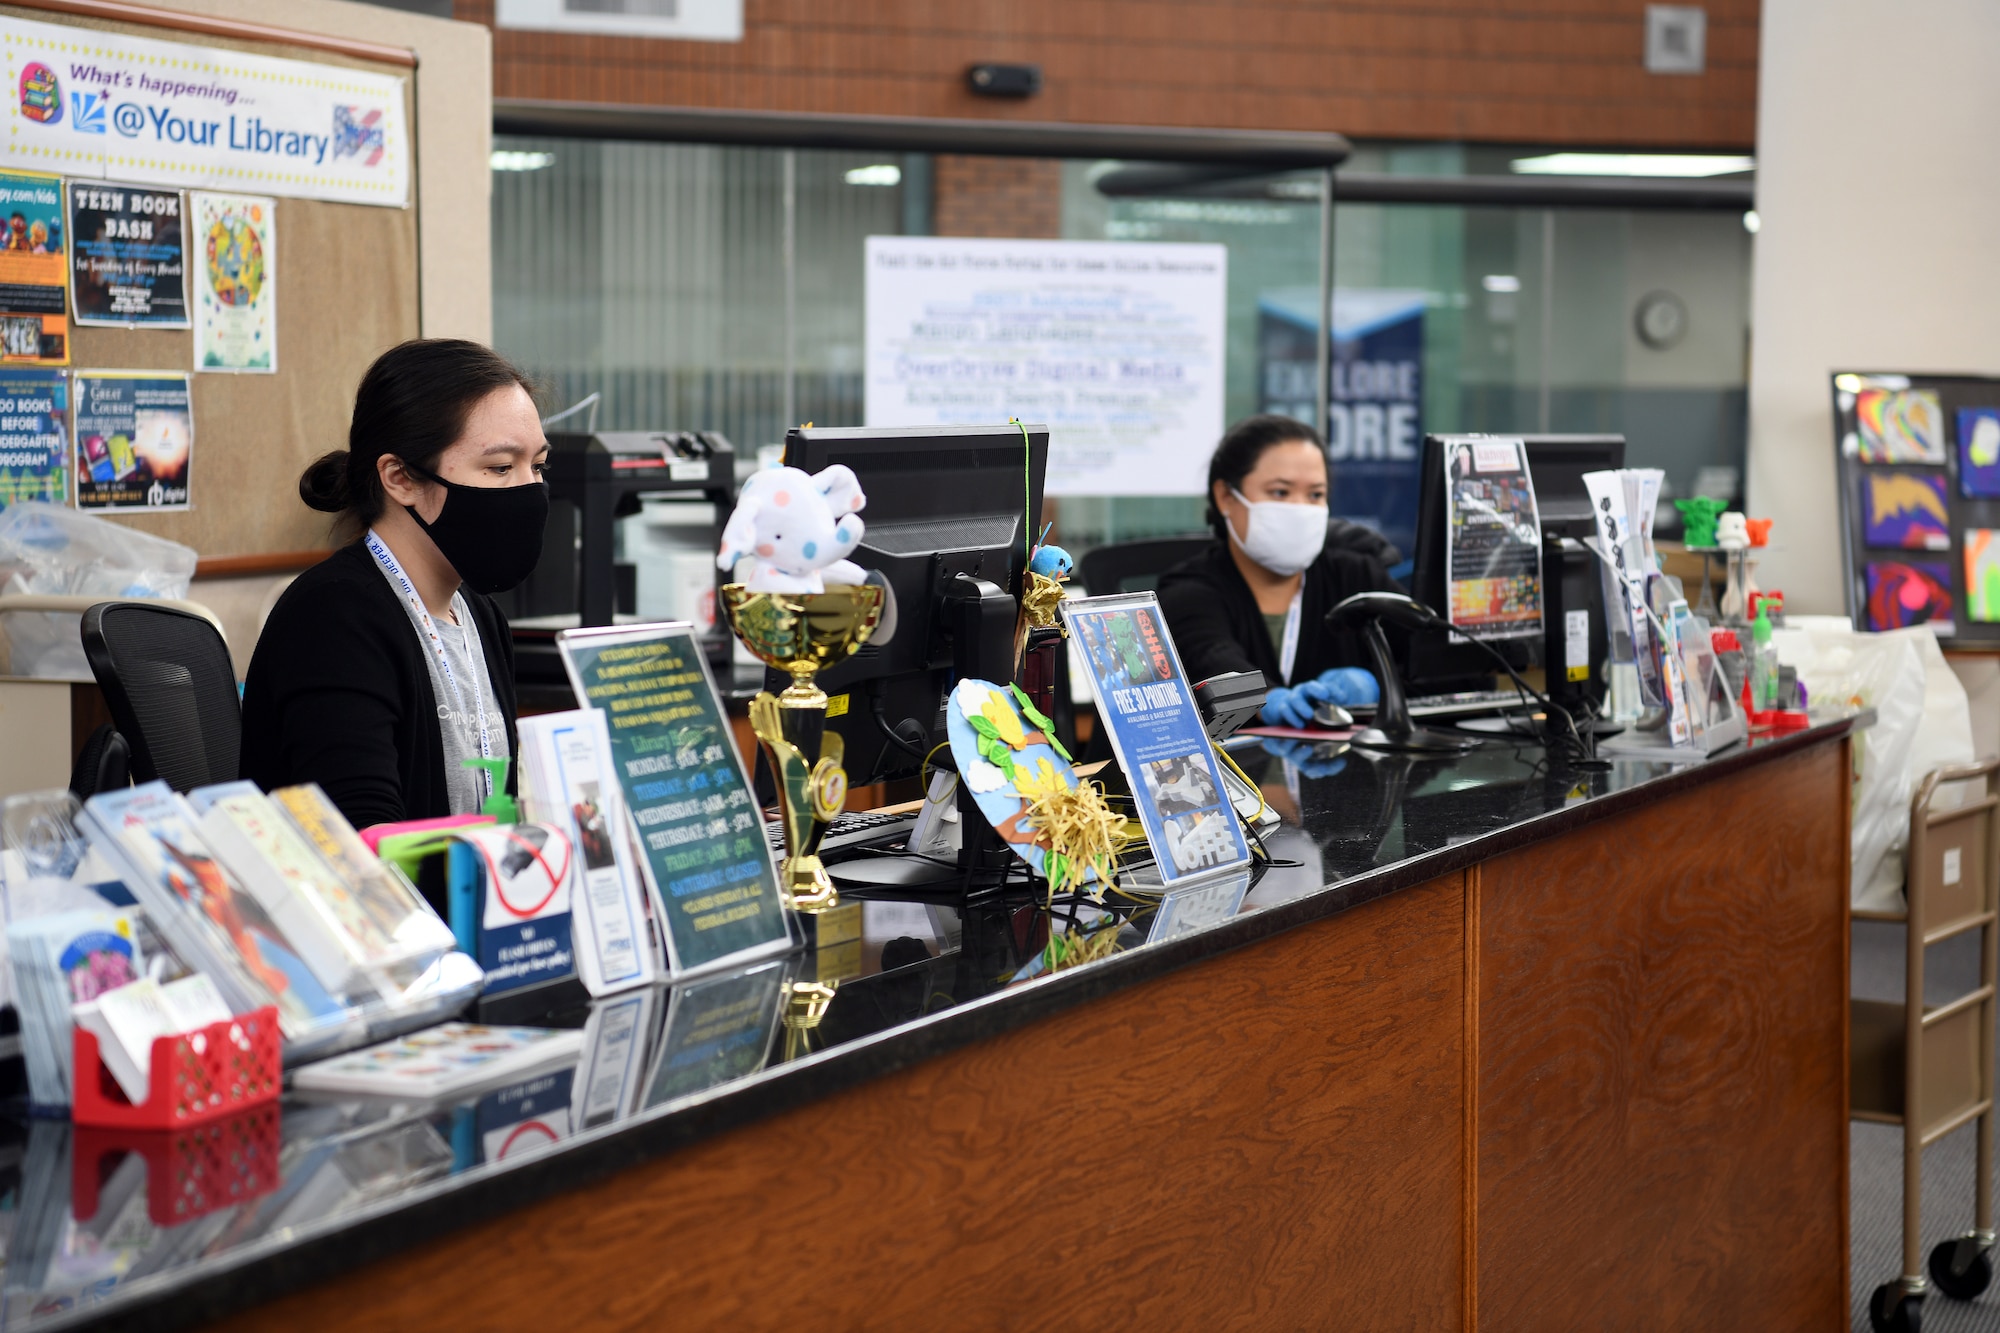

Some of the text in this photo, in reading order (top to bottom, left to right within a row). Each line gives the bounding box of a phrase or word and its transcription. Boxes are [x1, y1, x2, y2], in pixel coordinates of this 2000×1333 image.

[70, 63, 134, 89] What's
[228, 115, 329, 165] Library
[75, 191, 178, 217] TEEN BOOK
[105, 219, 153, 240] BASH
[1266, 360, 1418, 401] EXLORE
[17, 398, 52, 413] BOOKS
[2, 416, 39, 431] BEFORE
[0, 434, 60, 449] DERGARTEN
[1112, 682, 1183, 715] FREE 3D PRINTING
[625, 754, 674, 778] MONDAY:
[647, 822, 705, 851] THURSDAY:
[725, 859, 763, 882] CLOSED
